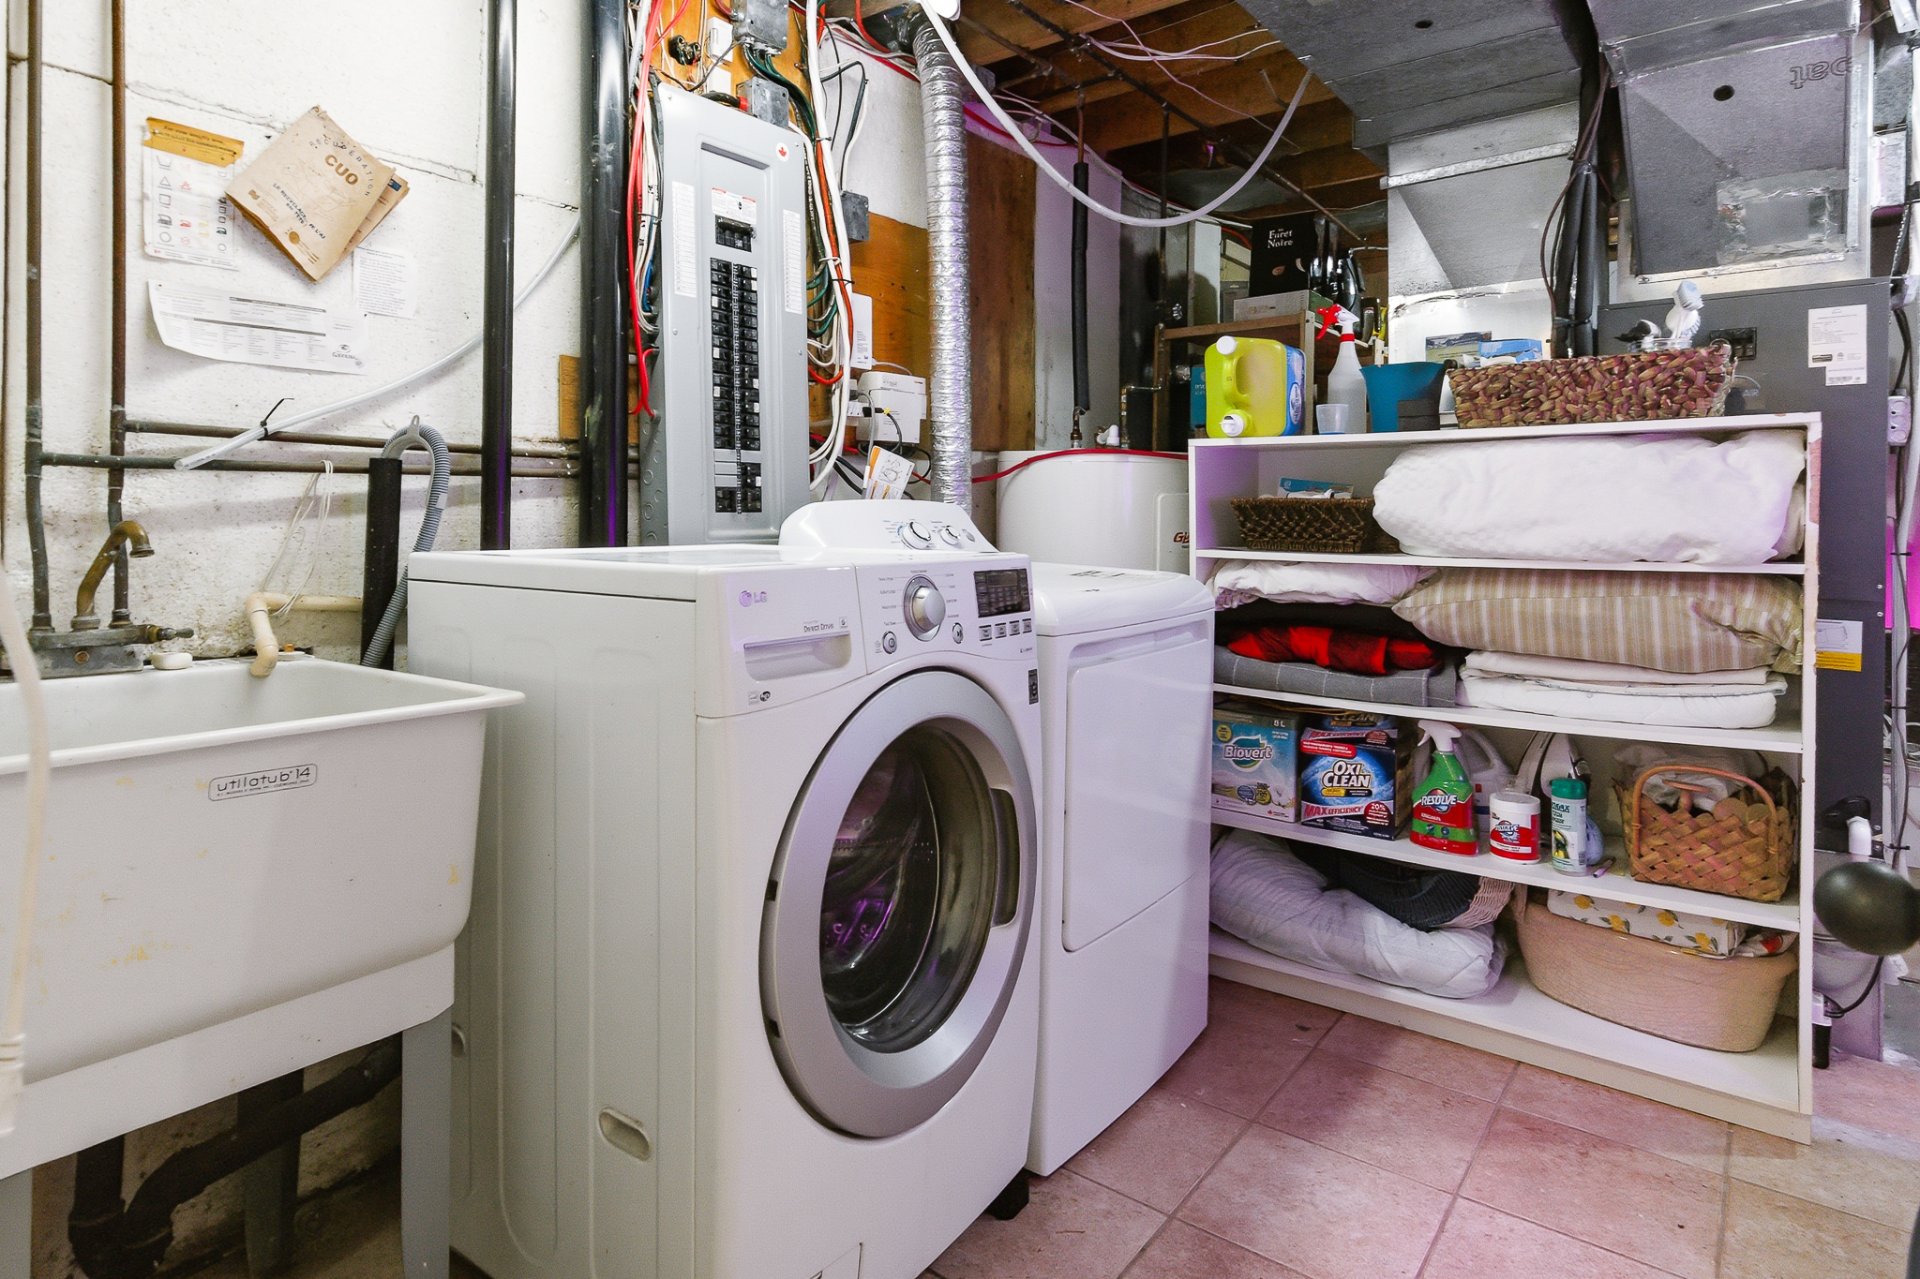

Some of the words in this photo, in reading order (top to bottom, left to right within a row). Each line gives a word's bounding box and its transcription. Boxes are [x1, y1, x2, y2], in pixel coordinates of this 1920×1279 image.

[325, 155, 358, 185] CUO
[753, 591, 768, 603] LG
[1224, 744, 1273, 758] Biovert
[295, 767, 311, 779] 14
[1333, 760, 1363, 775] OXI
[1322, 771, 1371, 788] CLEAN
[1421, 794, 1458, 806] RESOLVE
